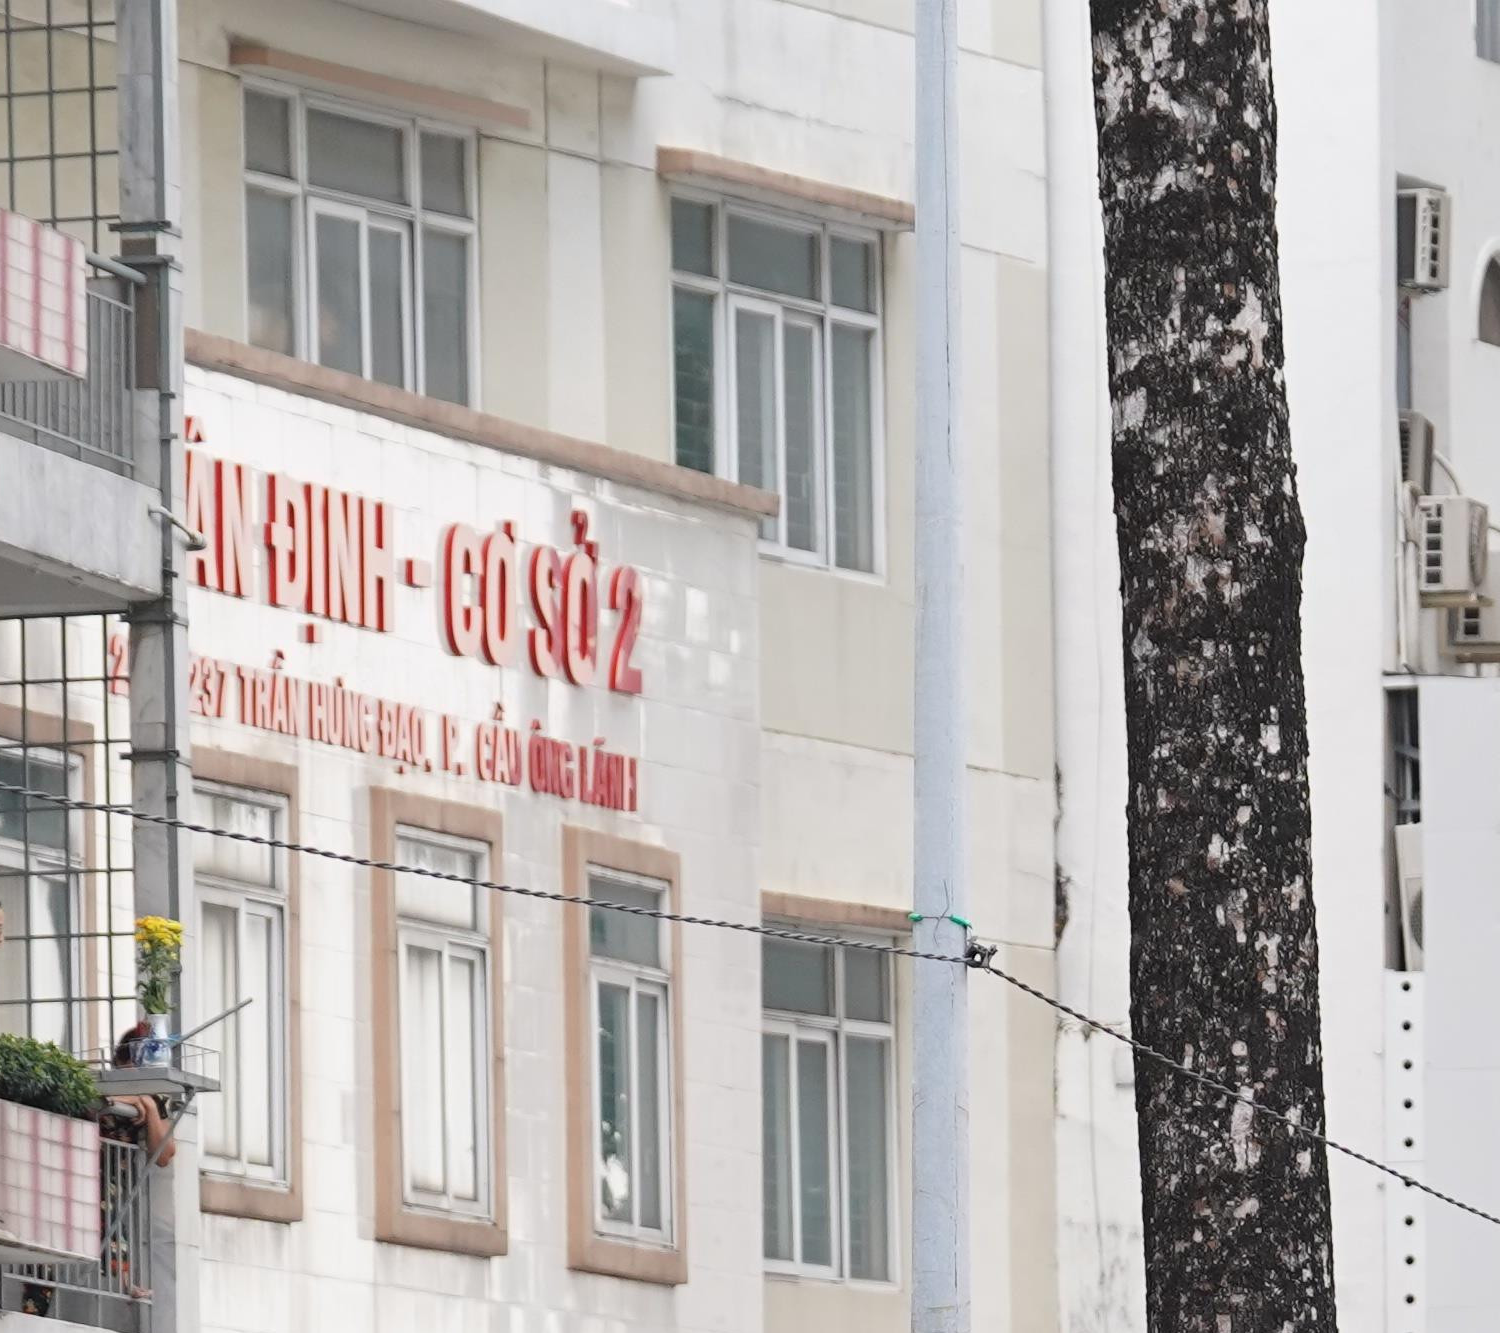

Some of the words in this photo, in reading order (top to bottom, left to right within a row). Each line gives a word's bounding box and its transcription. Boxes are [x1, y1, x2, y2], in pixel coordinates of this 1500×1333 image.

[262, 472, 394, 644] ĐỊNH
[440, 519, 519, 667] CƠ
[527, 508, 600, 687] SỞ
[608, 564, 644, 695] 2
[188, 656, 231, 719] 237
[236, 647, 301, 736] TRẦN
[475, 700, 523, 787] CẦU
[527, 718, 575, 799] ÔNG
